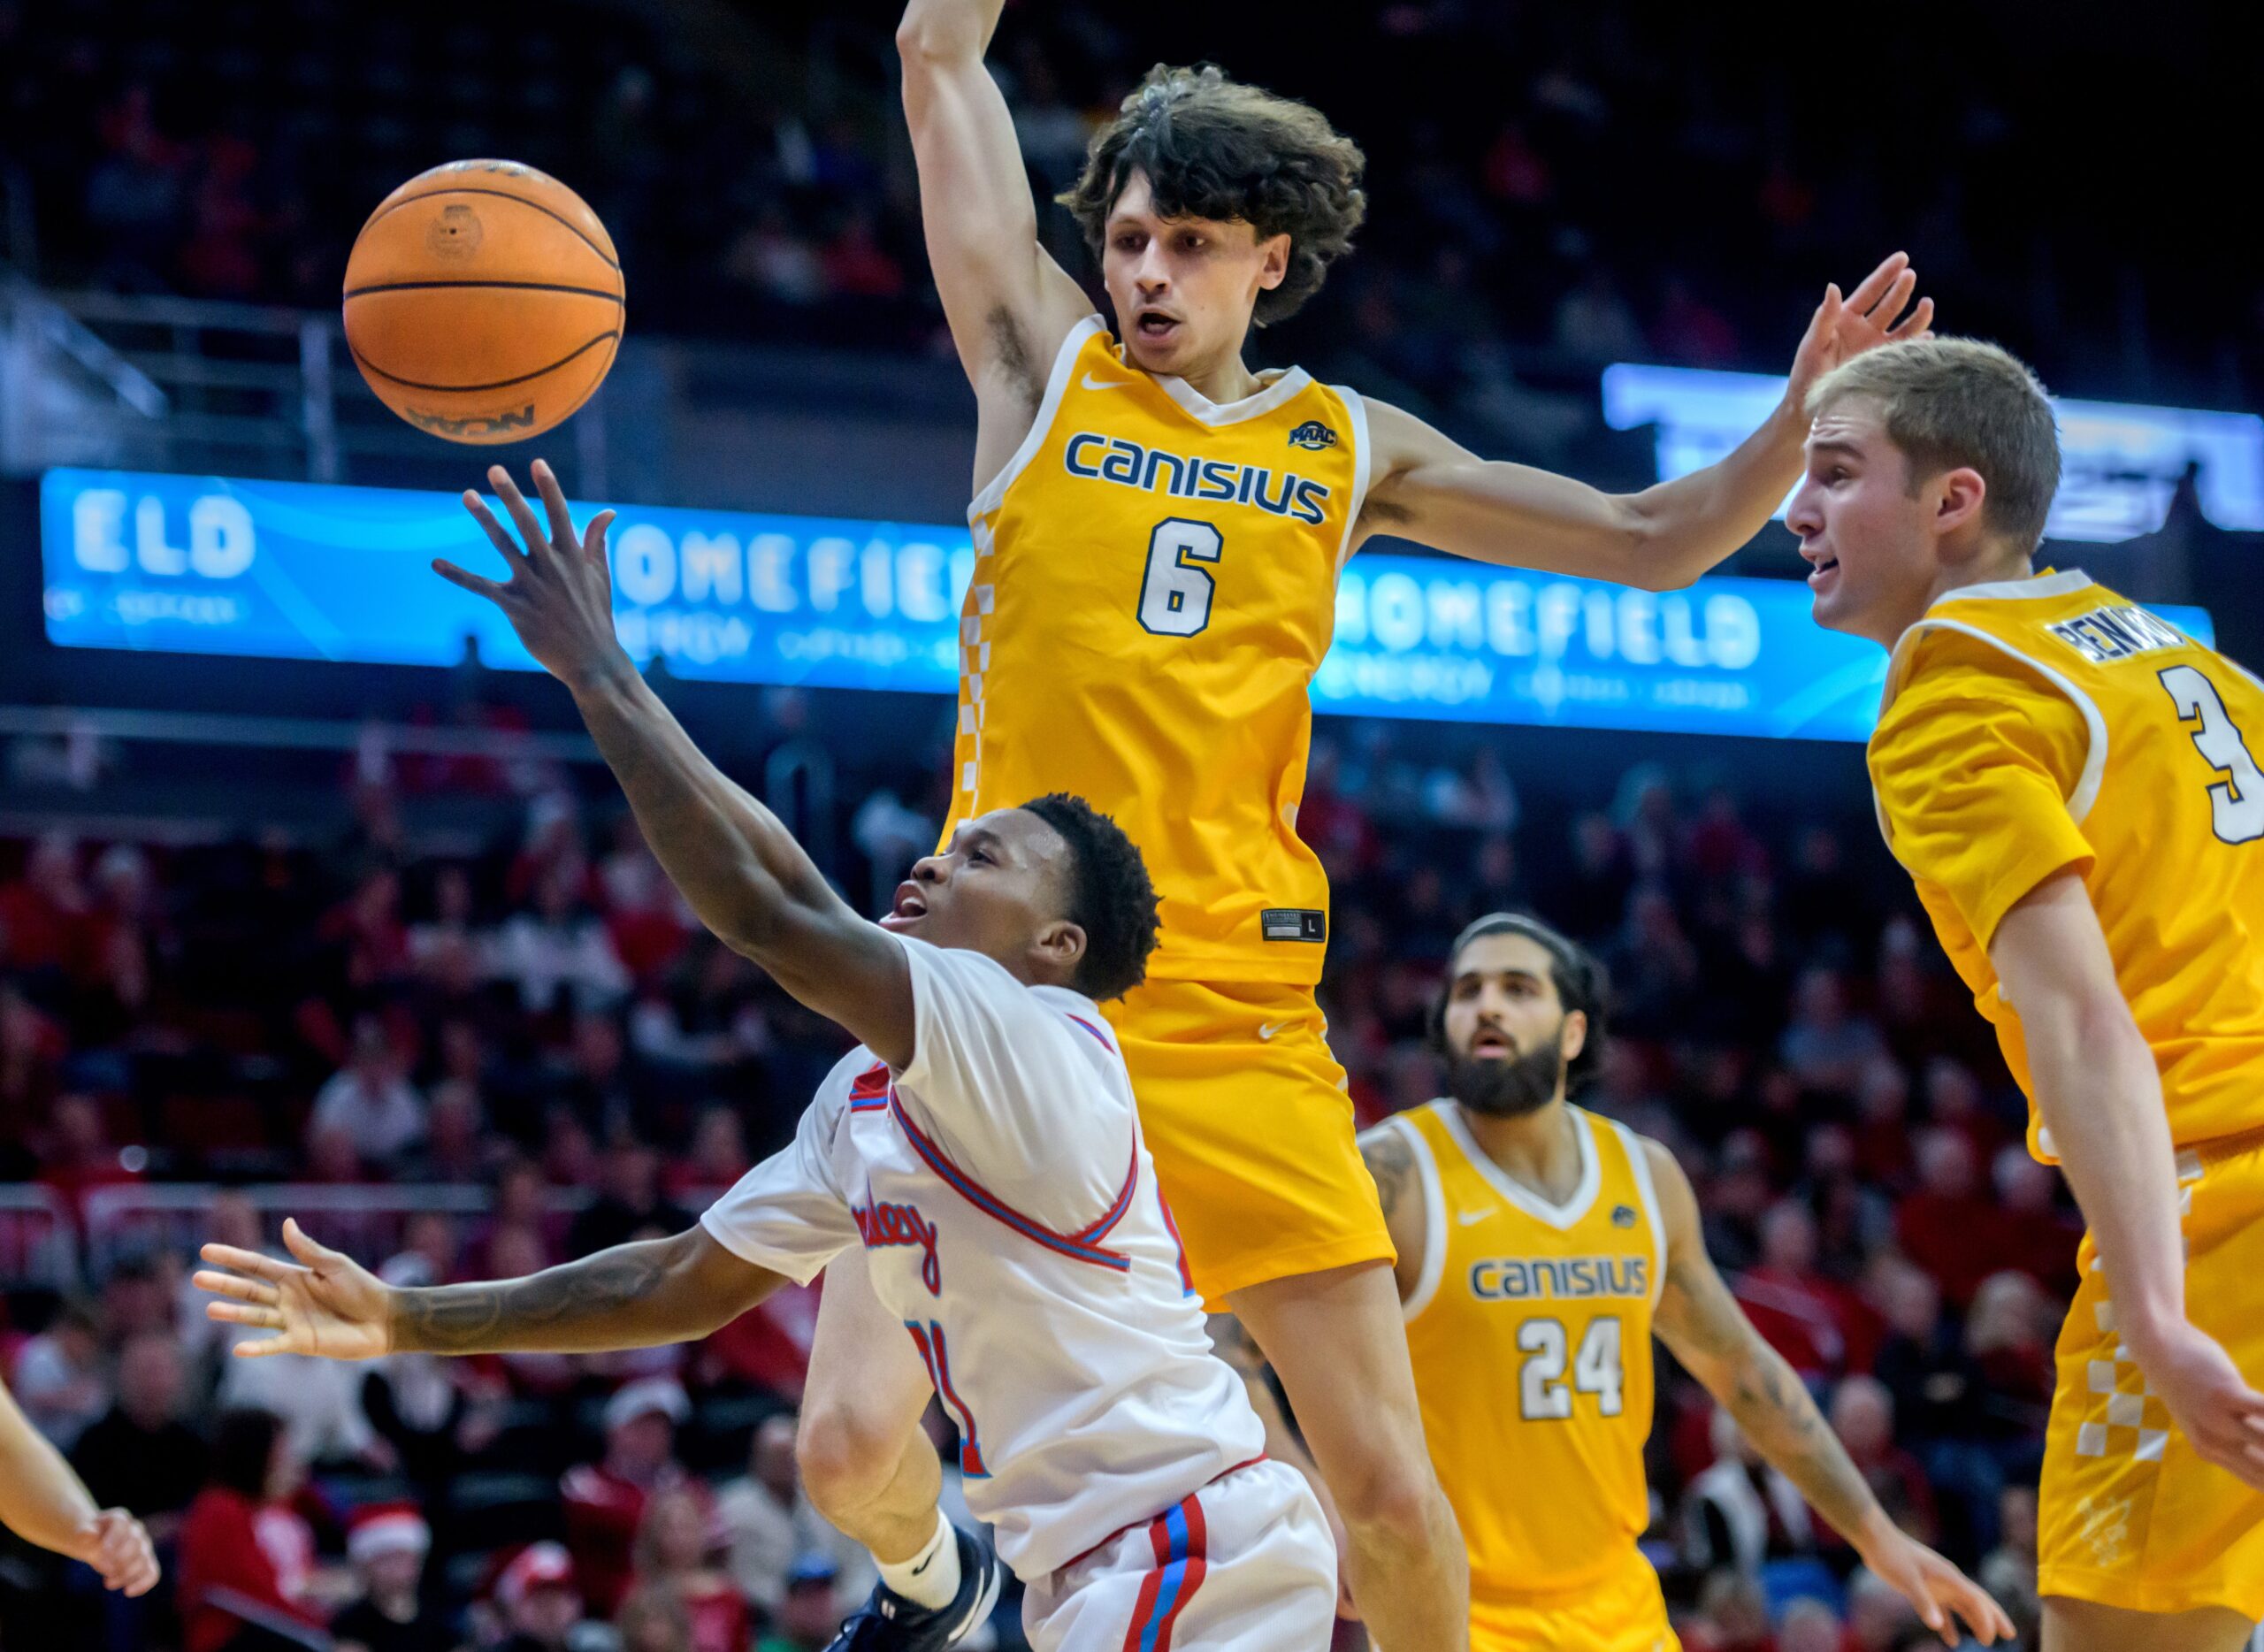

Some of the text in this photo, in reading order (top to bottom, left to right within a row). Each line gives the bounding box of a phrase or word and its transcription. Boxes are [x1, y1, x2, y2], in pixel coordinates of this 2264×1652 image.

[1288, 426, 1337, 447] MAAC
[73, 488, 256, 579] ELD
[1136, 516, 1224, 638] 6
[2156, 664, 2264, 846] 3
[1308, 919, 1316, 933] L
[1516, 1314, 1625, 1422] 24
